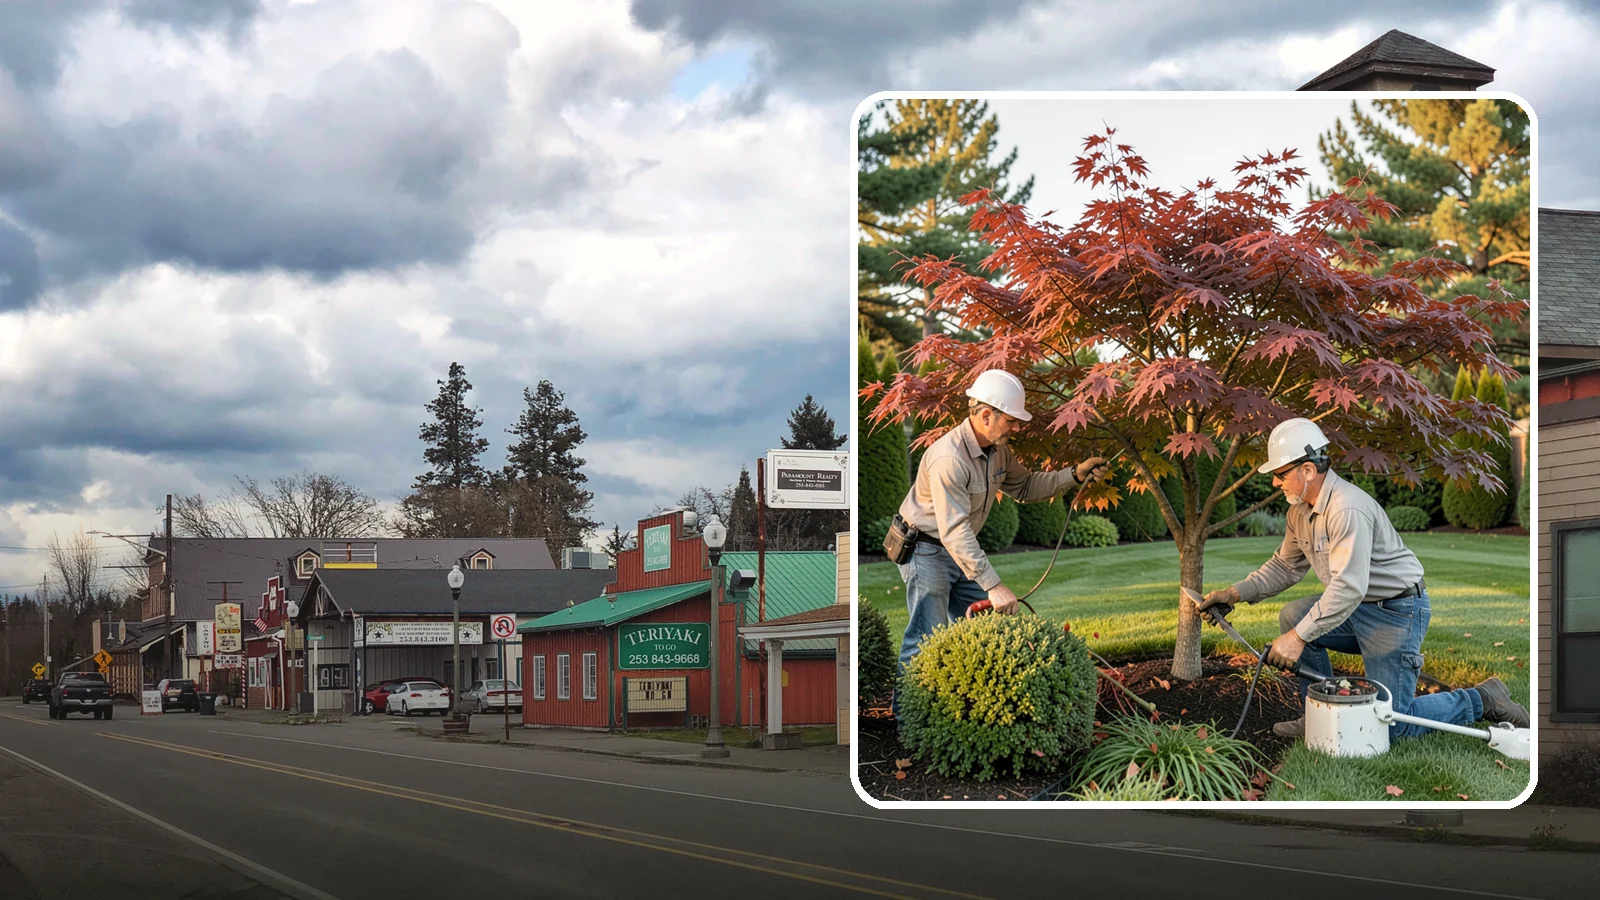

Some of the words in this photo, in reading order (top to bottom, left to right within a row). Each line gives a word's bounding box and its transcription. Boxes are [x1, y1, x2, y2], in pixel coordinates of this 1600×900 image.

[624, 627, 702, 646] TERIYAKI
[629, 655, 648, 664] 253
[652, 654, 700, 664] 843-9668
[639, 681, 672, 691] TERIYAKI
